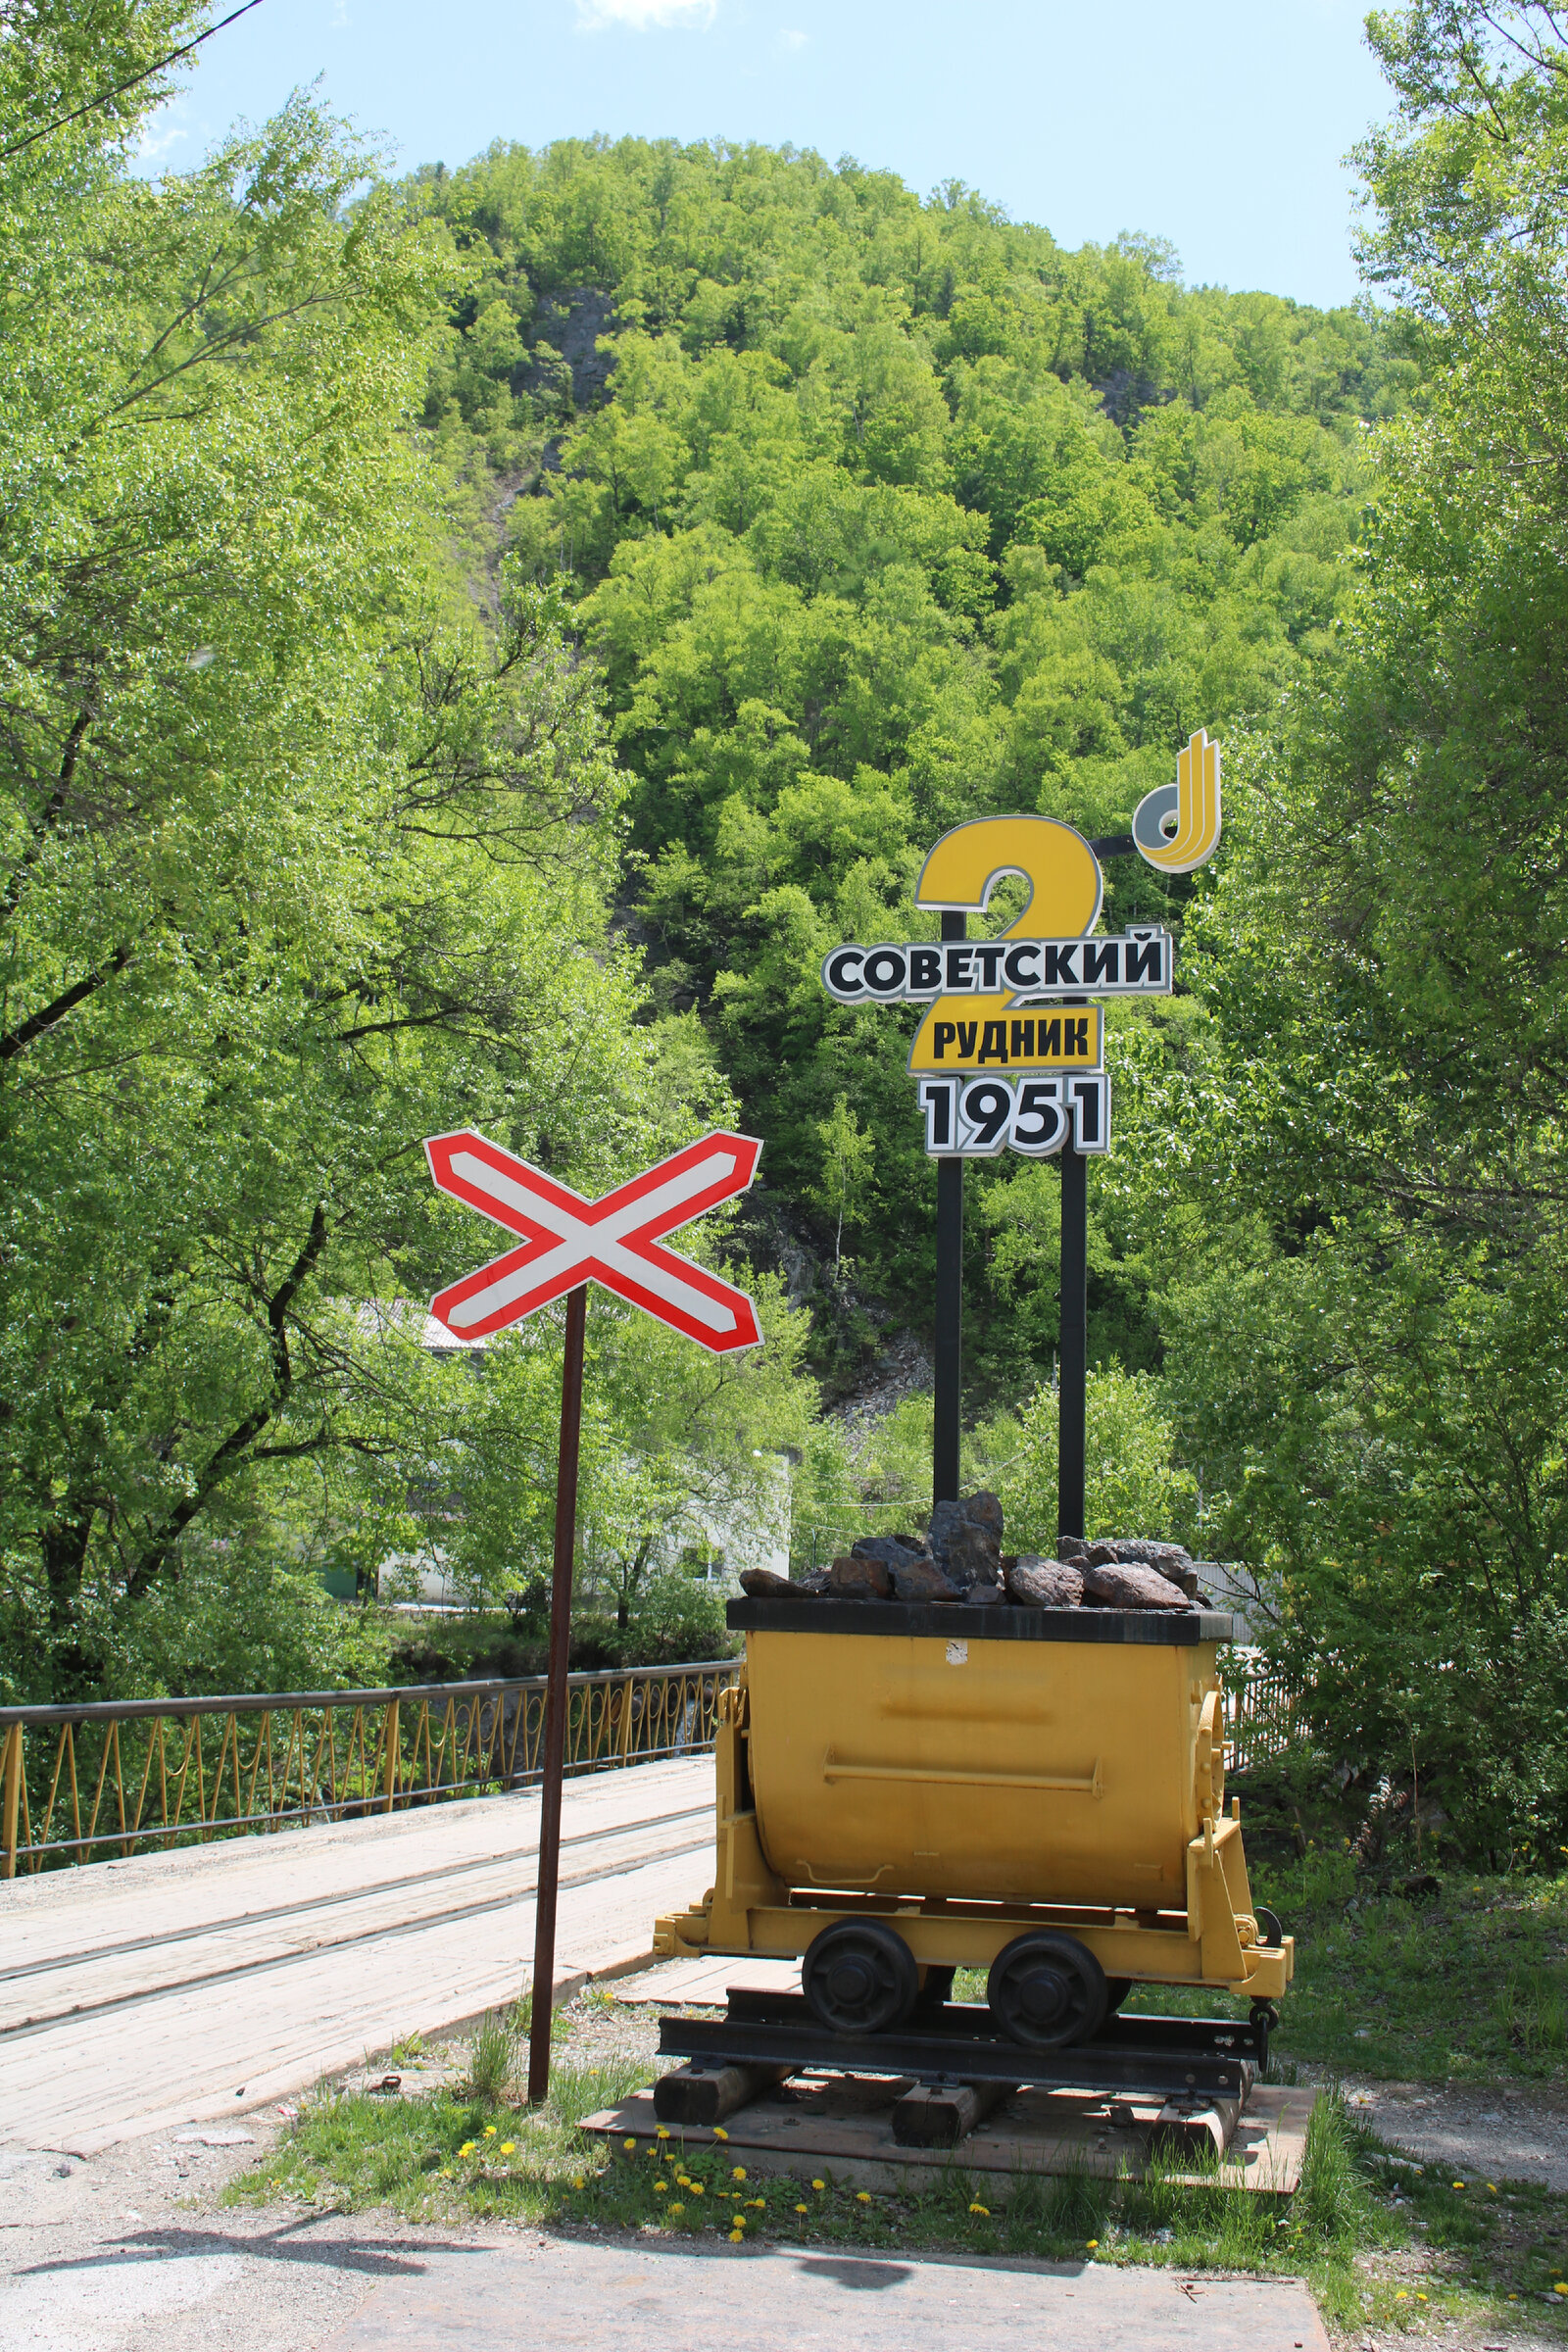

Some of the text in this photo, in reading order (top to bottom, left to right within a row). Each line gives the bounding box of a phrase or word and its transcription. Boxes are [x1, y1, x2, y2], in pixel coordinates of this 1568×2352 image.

[829, 933, 1161, 992] СОВЕТСКИЙ
[908, 814, 1103, 1071] 2
[933, 1018, 1089, 1064] РУДНИК
[925, 1083, 1099, 1145] 1951
